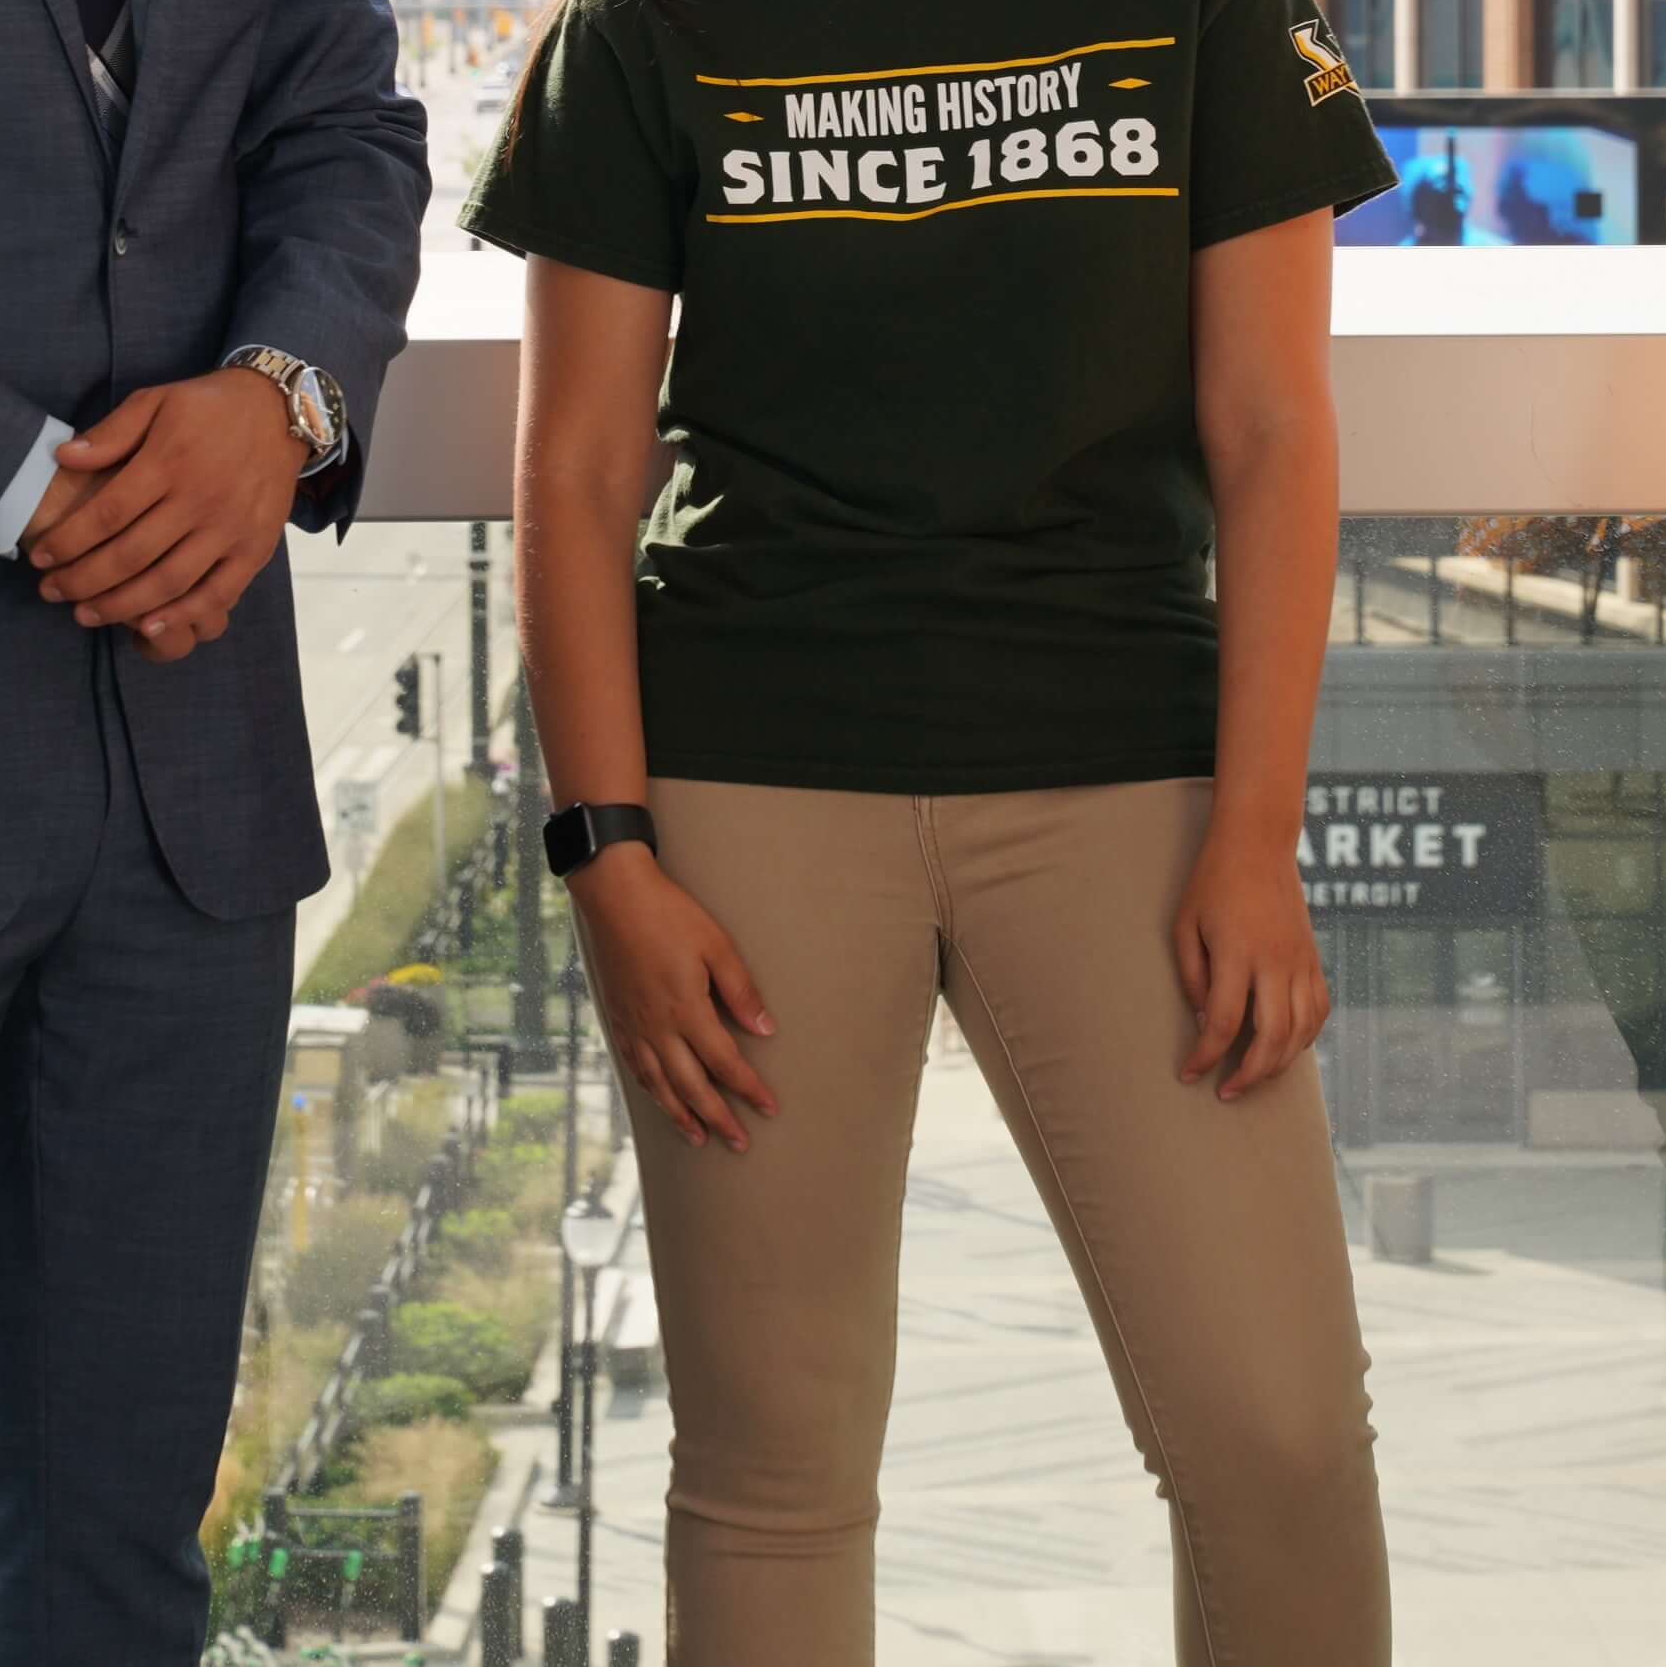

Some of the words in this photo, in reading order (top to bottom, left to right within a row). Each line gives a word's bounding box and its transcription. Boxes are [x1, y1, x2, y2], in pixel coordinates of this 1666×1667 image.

[784, 84, 928, 139] MAKING
[936, 62, 1083, 131] HISTORY
[722, 146, 948, 205] SINCE
[967, 117, 1160, 190] 1868
[1307, 786, 1444, 816] STRICT
